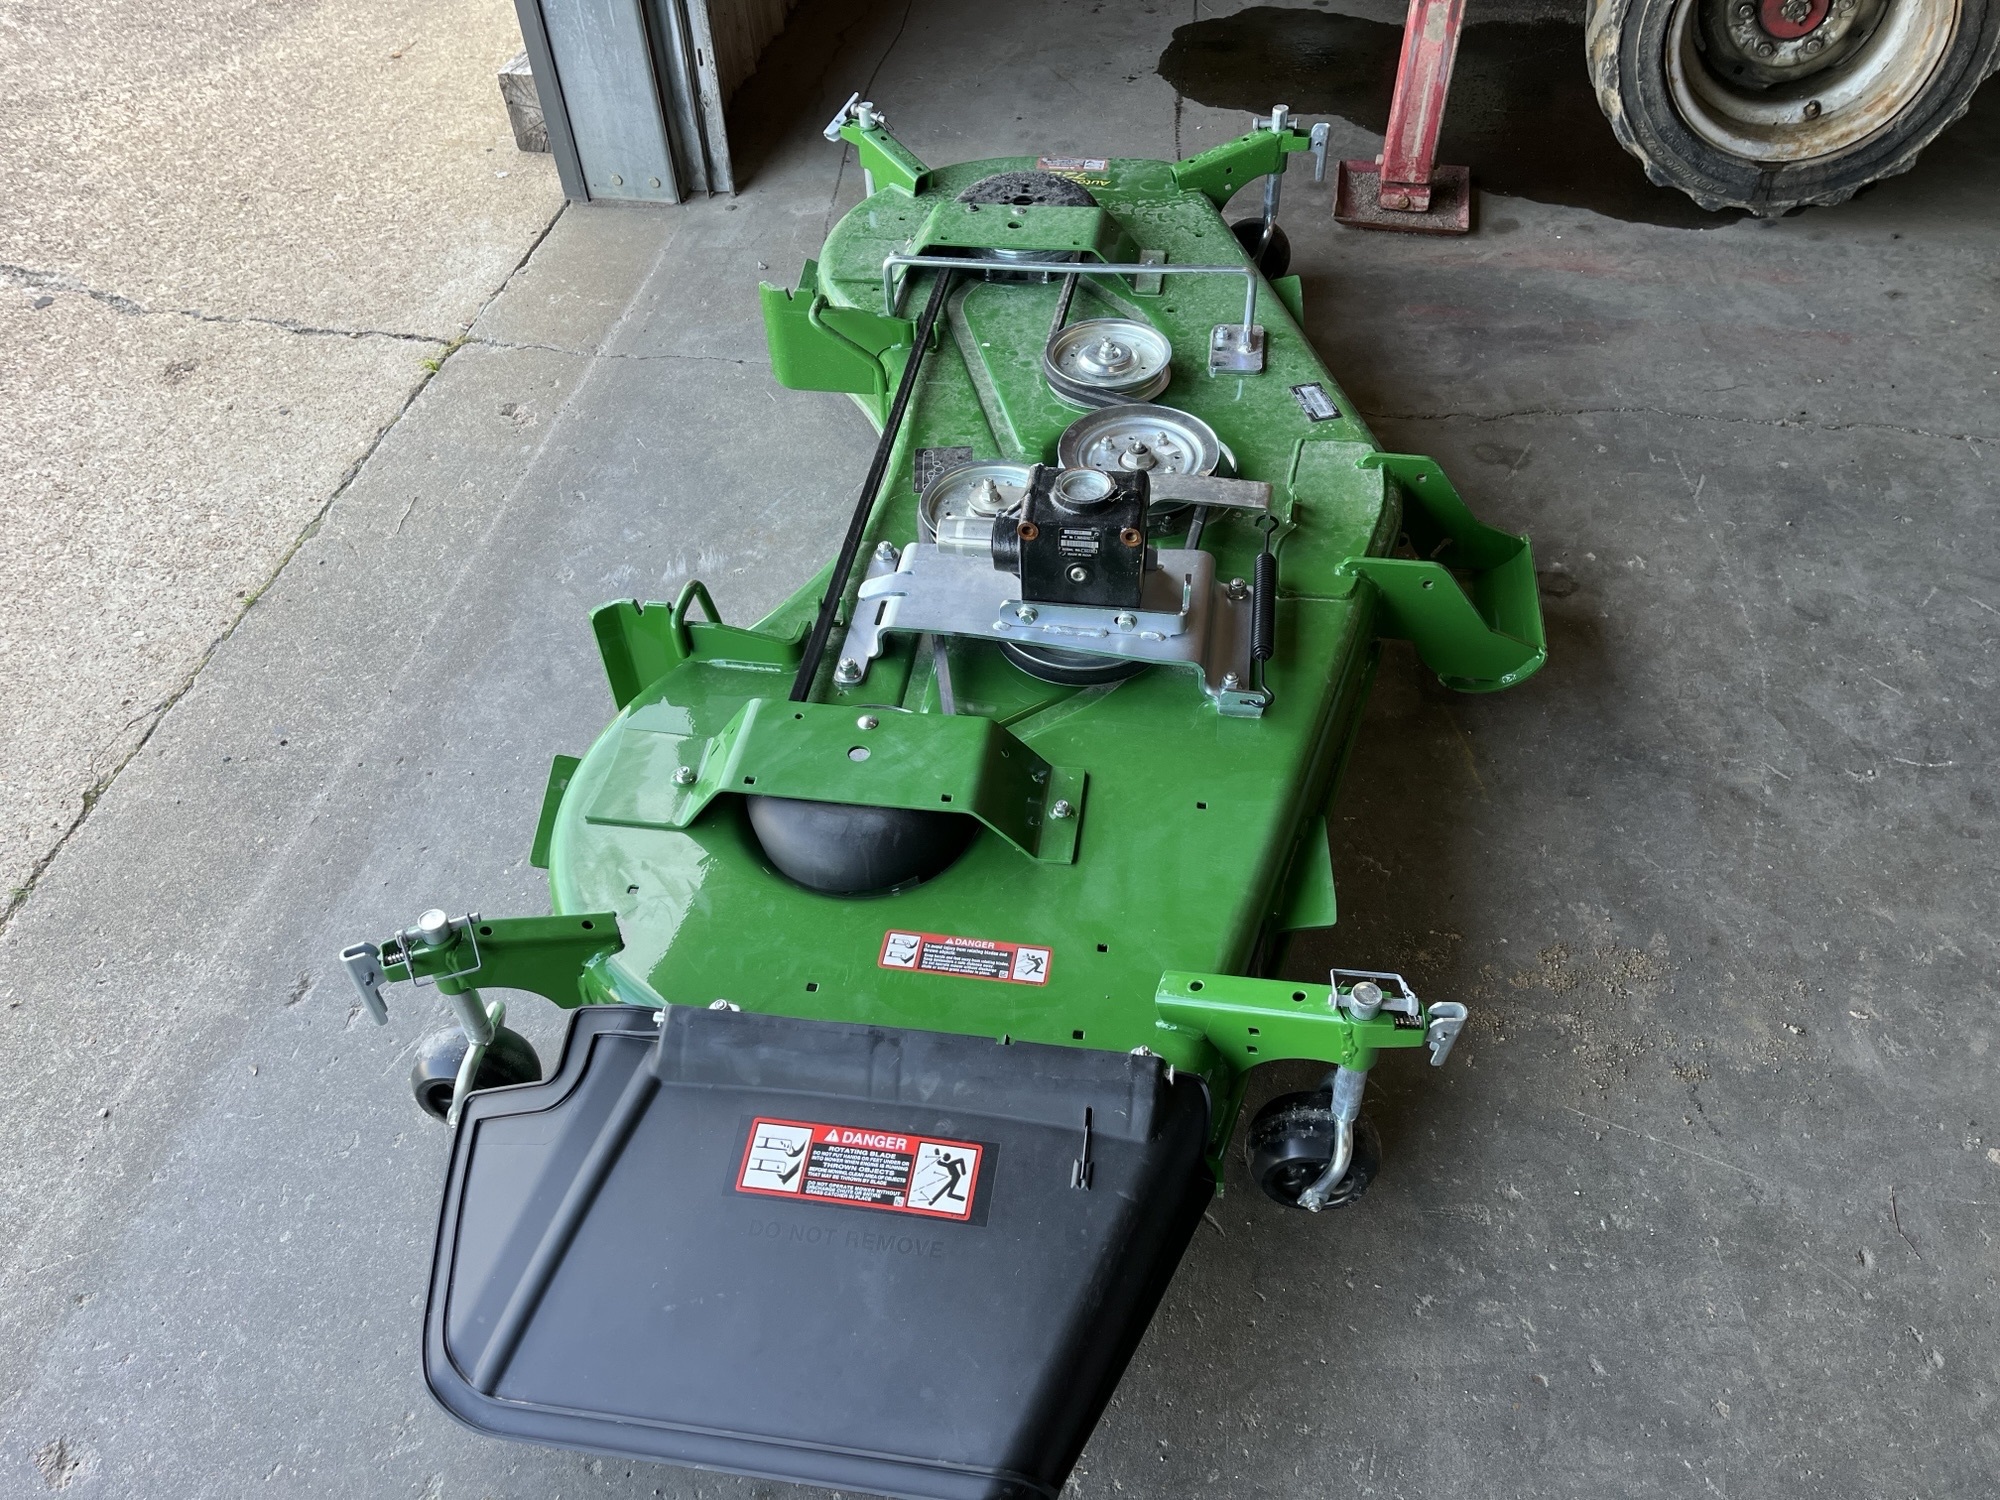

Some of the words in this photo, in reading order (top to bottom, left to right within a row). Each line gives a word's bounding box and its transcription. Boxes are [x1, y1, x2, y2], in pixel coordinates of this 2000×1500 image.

[955, 938, 994, 948] DANGER
[841, 1131, 907, 1150] DANGER
[828, 1146, 868, 1155] ROTATING
[869, 1151, 896, 1159] BLADE
[822, 1161, 857, 1171] THROWN
[858, 1166, 894, 1176] OBJECTS
[749, 1219, 781, 1239] DO
[789, 1224, 837, 1246] NOT
[844, 1230, 944, 1258] REMOVE
